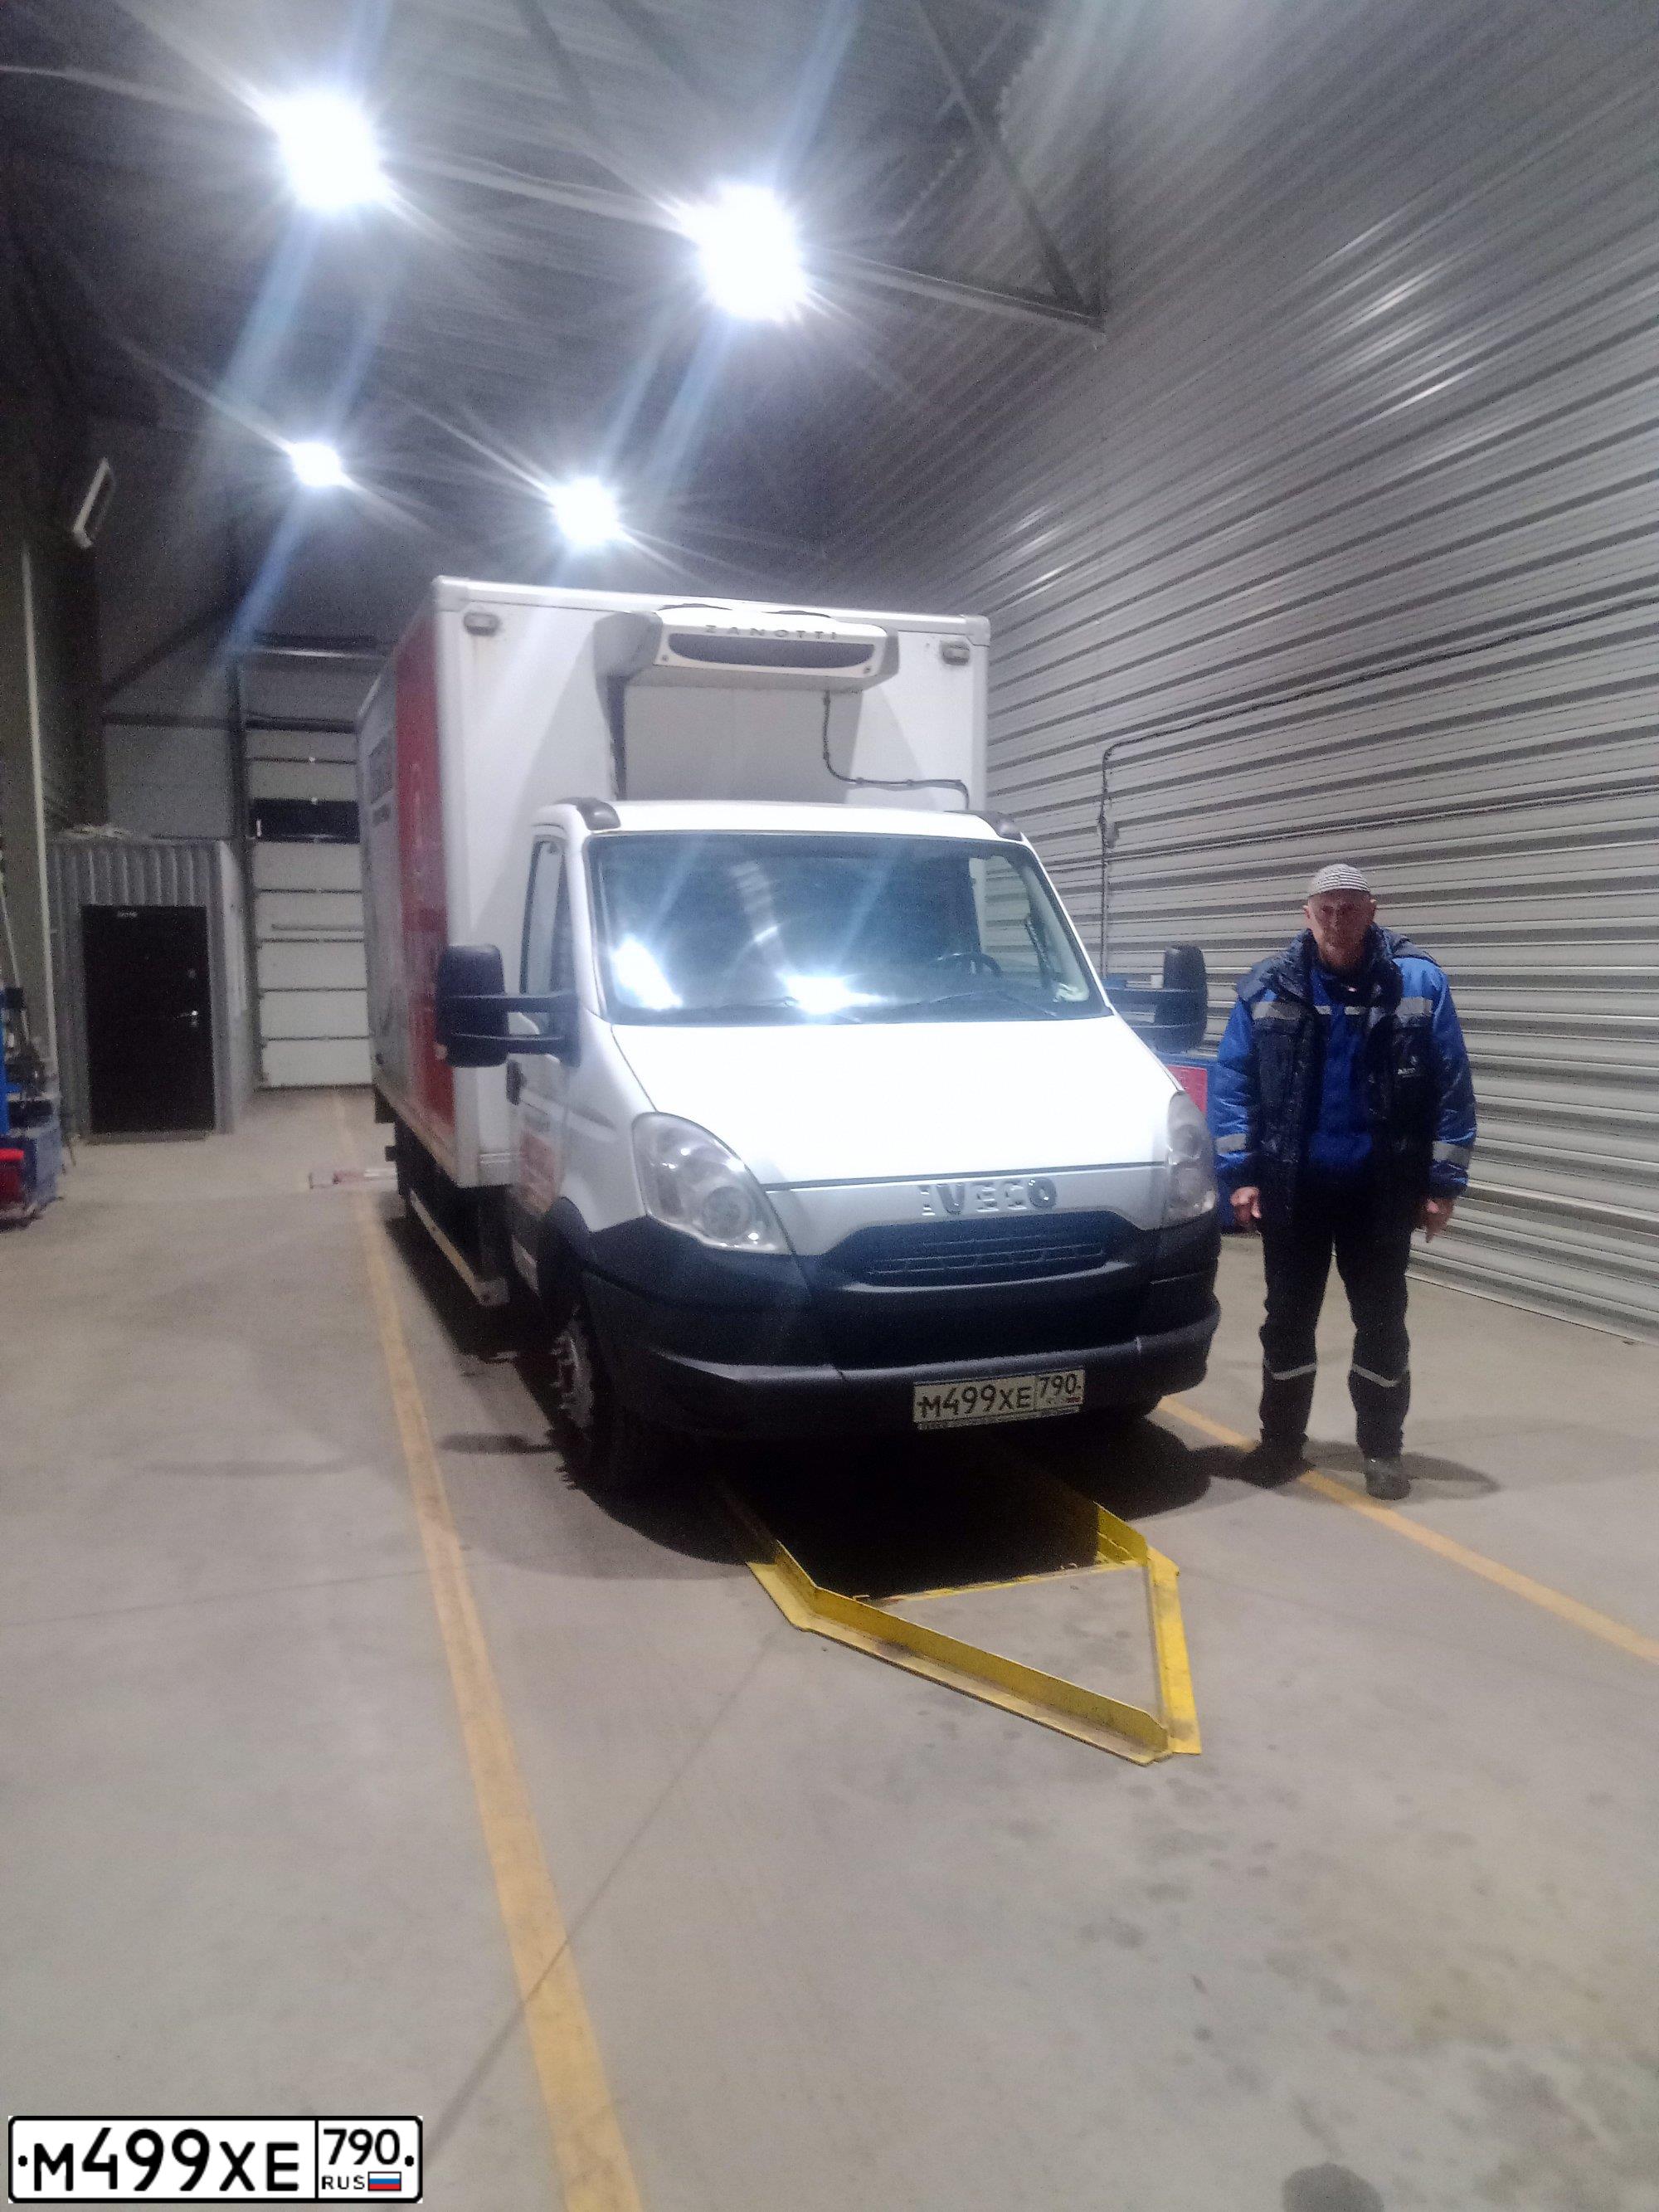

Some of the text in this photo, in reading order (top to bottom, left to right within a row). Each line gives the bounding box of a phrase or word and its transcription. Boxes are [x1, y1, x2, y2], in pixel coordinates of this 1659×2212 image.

[705, 624, 837, 641] ZANOTTI
[917, 1177, 1058, 1216] IVECO
[920, 1372, 1078, 1419] М499ХЕ 790
